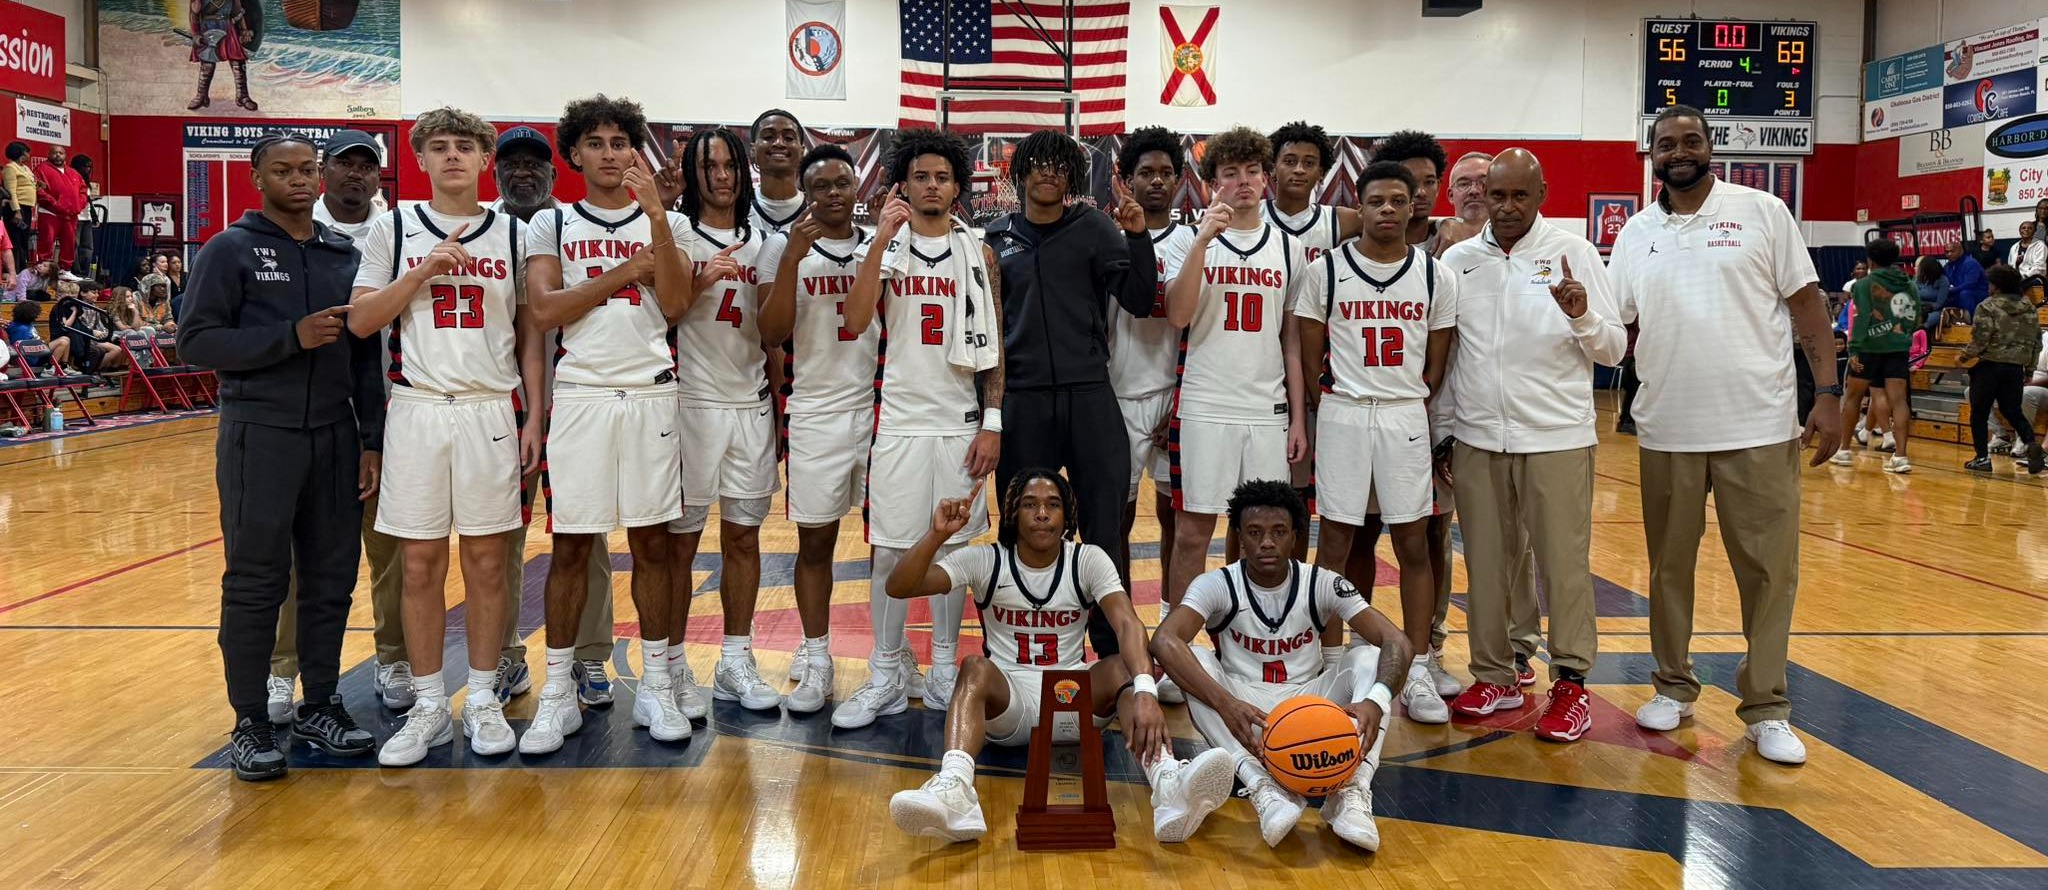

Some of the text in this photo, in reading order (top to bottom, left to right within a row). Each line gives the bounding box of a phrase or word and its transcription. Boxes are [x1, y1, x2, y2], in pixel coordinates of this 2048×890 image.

[1651, 24, 1691, 34] GUEST
[1715, 25, 1746, 47] 0.0
[1770, 26, 1810, 37] VIKINGS
[1659, 39, 1686, 62] 56
[1778, 41, 1804, 63] 69
[1698, 56, 1750, 73] PERIOD 4
[1666, 88, 1795, 107] 5 0 3
[26, 108, 61, 122] RESTROOMS
[38, 120, 50, 128] AND
[26, 126, 62, 138] CONCESSIONS
[186, 126, 229, 138] VIKING
[234, 126, 263, 138] BOYS
[1760, 127, 1809, 147] VIKINGS
[2020, 168, 2042, 183] City
[2018, 188, 2035, 200] 850
[1709, 222, 1742, 230] VIKING
[253, 247, 276, 256] FWB
[1708, 240, 1741, 248] BASKETBALL
[255, 271, 290, 282] VIKINGS
[1204, 266, 1282, 288] VIKINGS
[430, 284, 484, 329] 23
[715, 288, 742, 328] 4
[1224, 292, 1263, 332] 10
[1339, 301, 1424, 321] VIKINGS
[921, 303, 944, 345] 2
[1362, 327, 1404, 367] 12
[992, 604, 1081, 628] VIKINGS
[1014, 632, 1058, 666] 13
[1230, 626, 1314, 655] VIKINGS
[1290, 748, 1355, 771] Wilson
